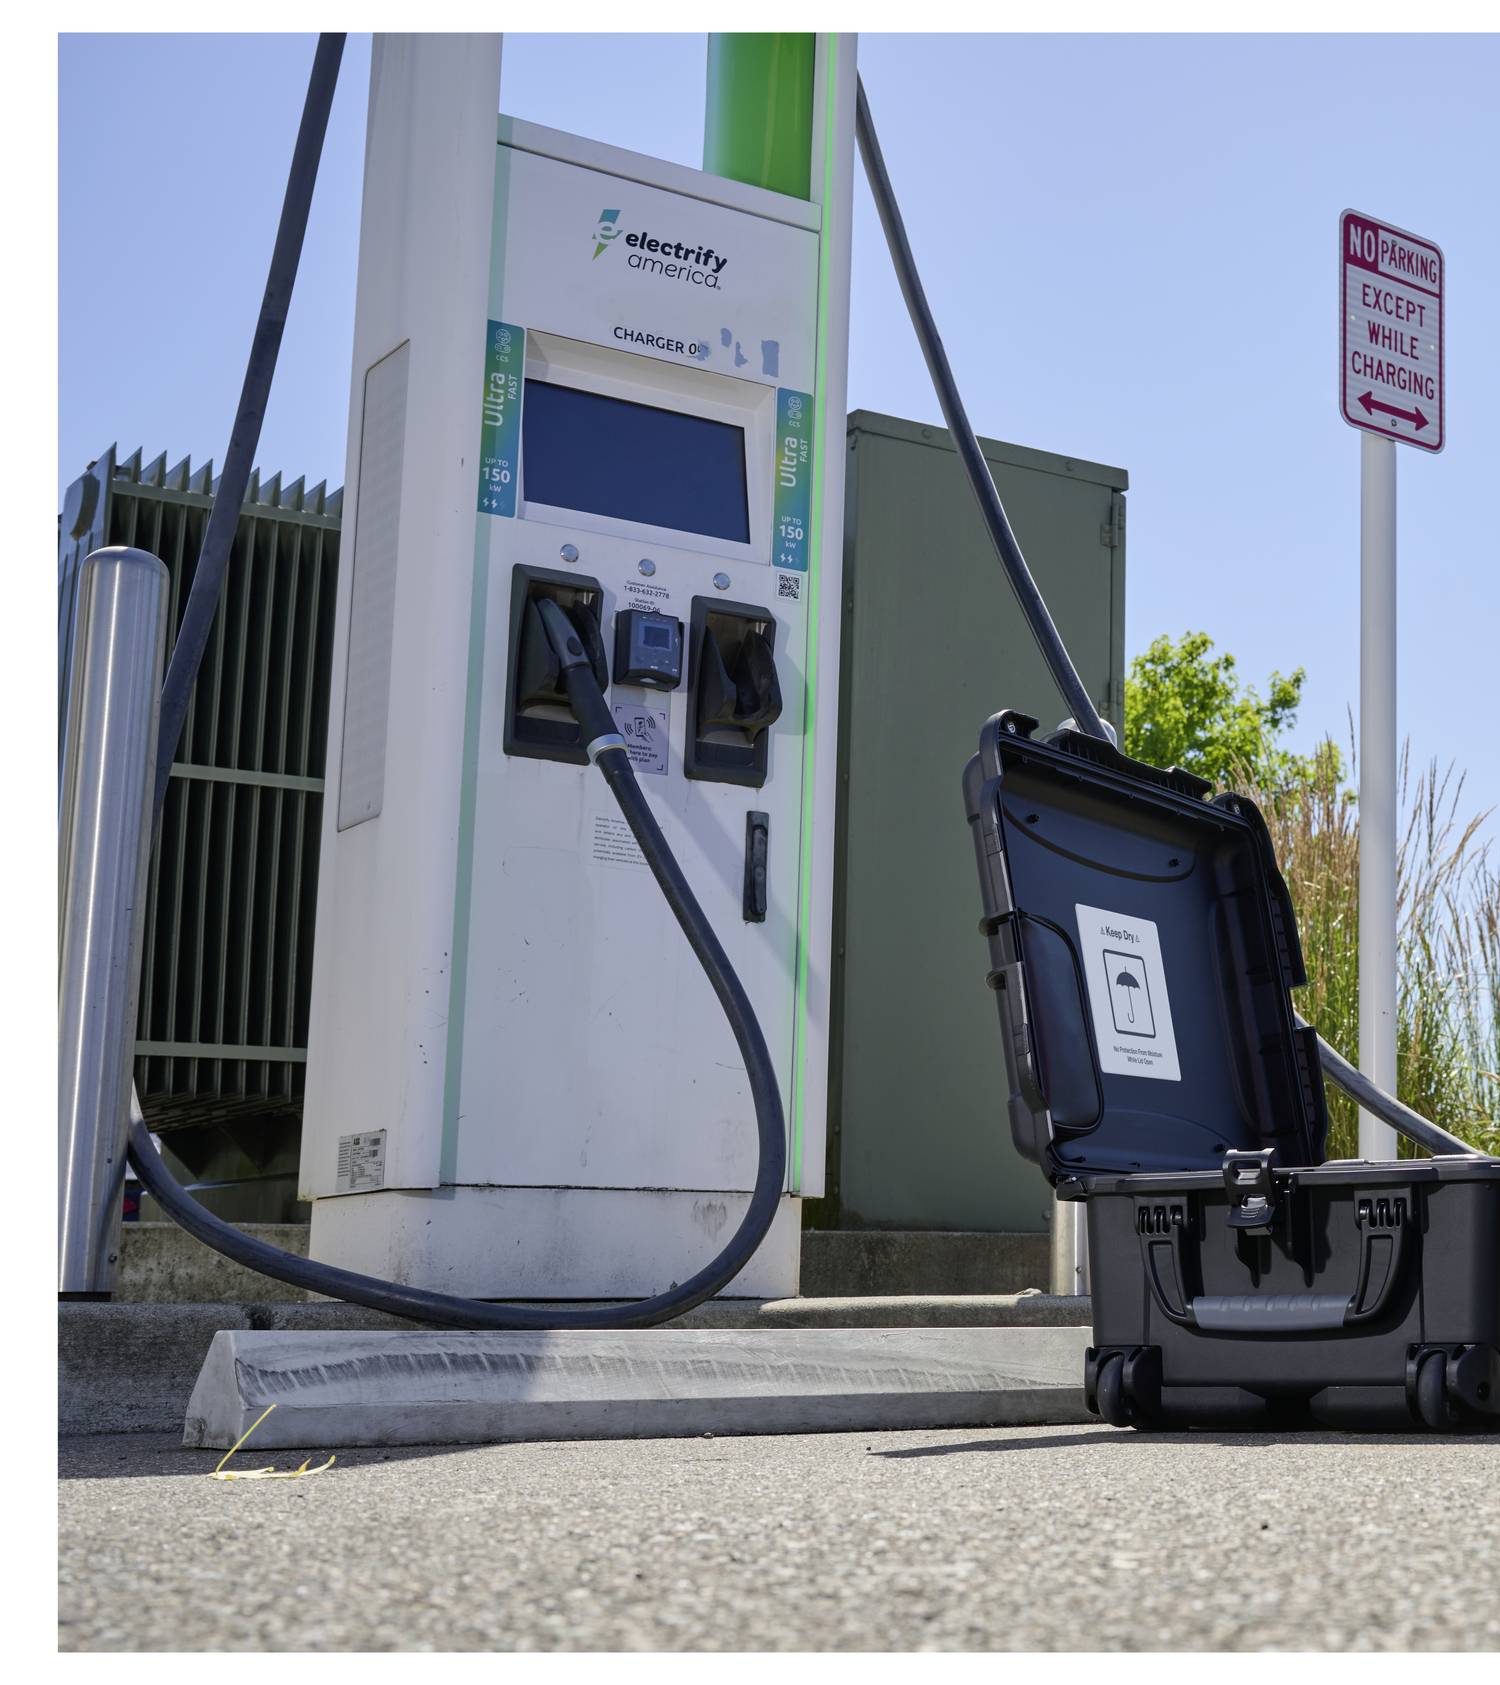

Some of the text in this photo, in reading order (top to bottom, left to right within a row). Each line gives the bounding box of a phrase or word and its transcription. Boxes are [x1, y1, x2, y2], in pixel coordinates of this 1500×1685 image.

[625, 232, 728, 273] electrify
[1350, 224, 1438, 284] NO PARKING
[627, 254, 719, 288] america
[1362, 283, 1426, 328] EXCEPT
[613, 326, 685, 354] CHARGER
[1367, 320, 1420, 361] WHILE
[507, 376, 518, 400] FAST
[1351, 350, 1435, 401] CHARGING
[484, 372, 506, 427] Ultra
[485, 457, 509, 467] UP TO
[779, 437, 798, 488] Ultra
[799, 439, 808, 463] FAST
[482, 467, 511, 484] 150
[779, 525, 804, 540] 150
[781, 515, 802, 526] UP TO
[1105, 926, 1134, 943] Keep Dry
